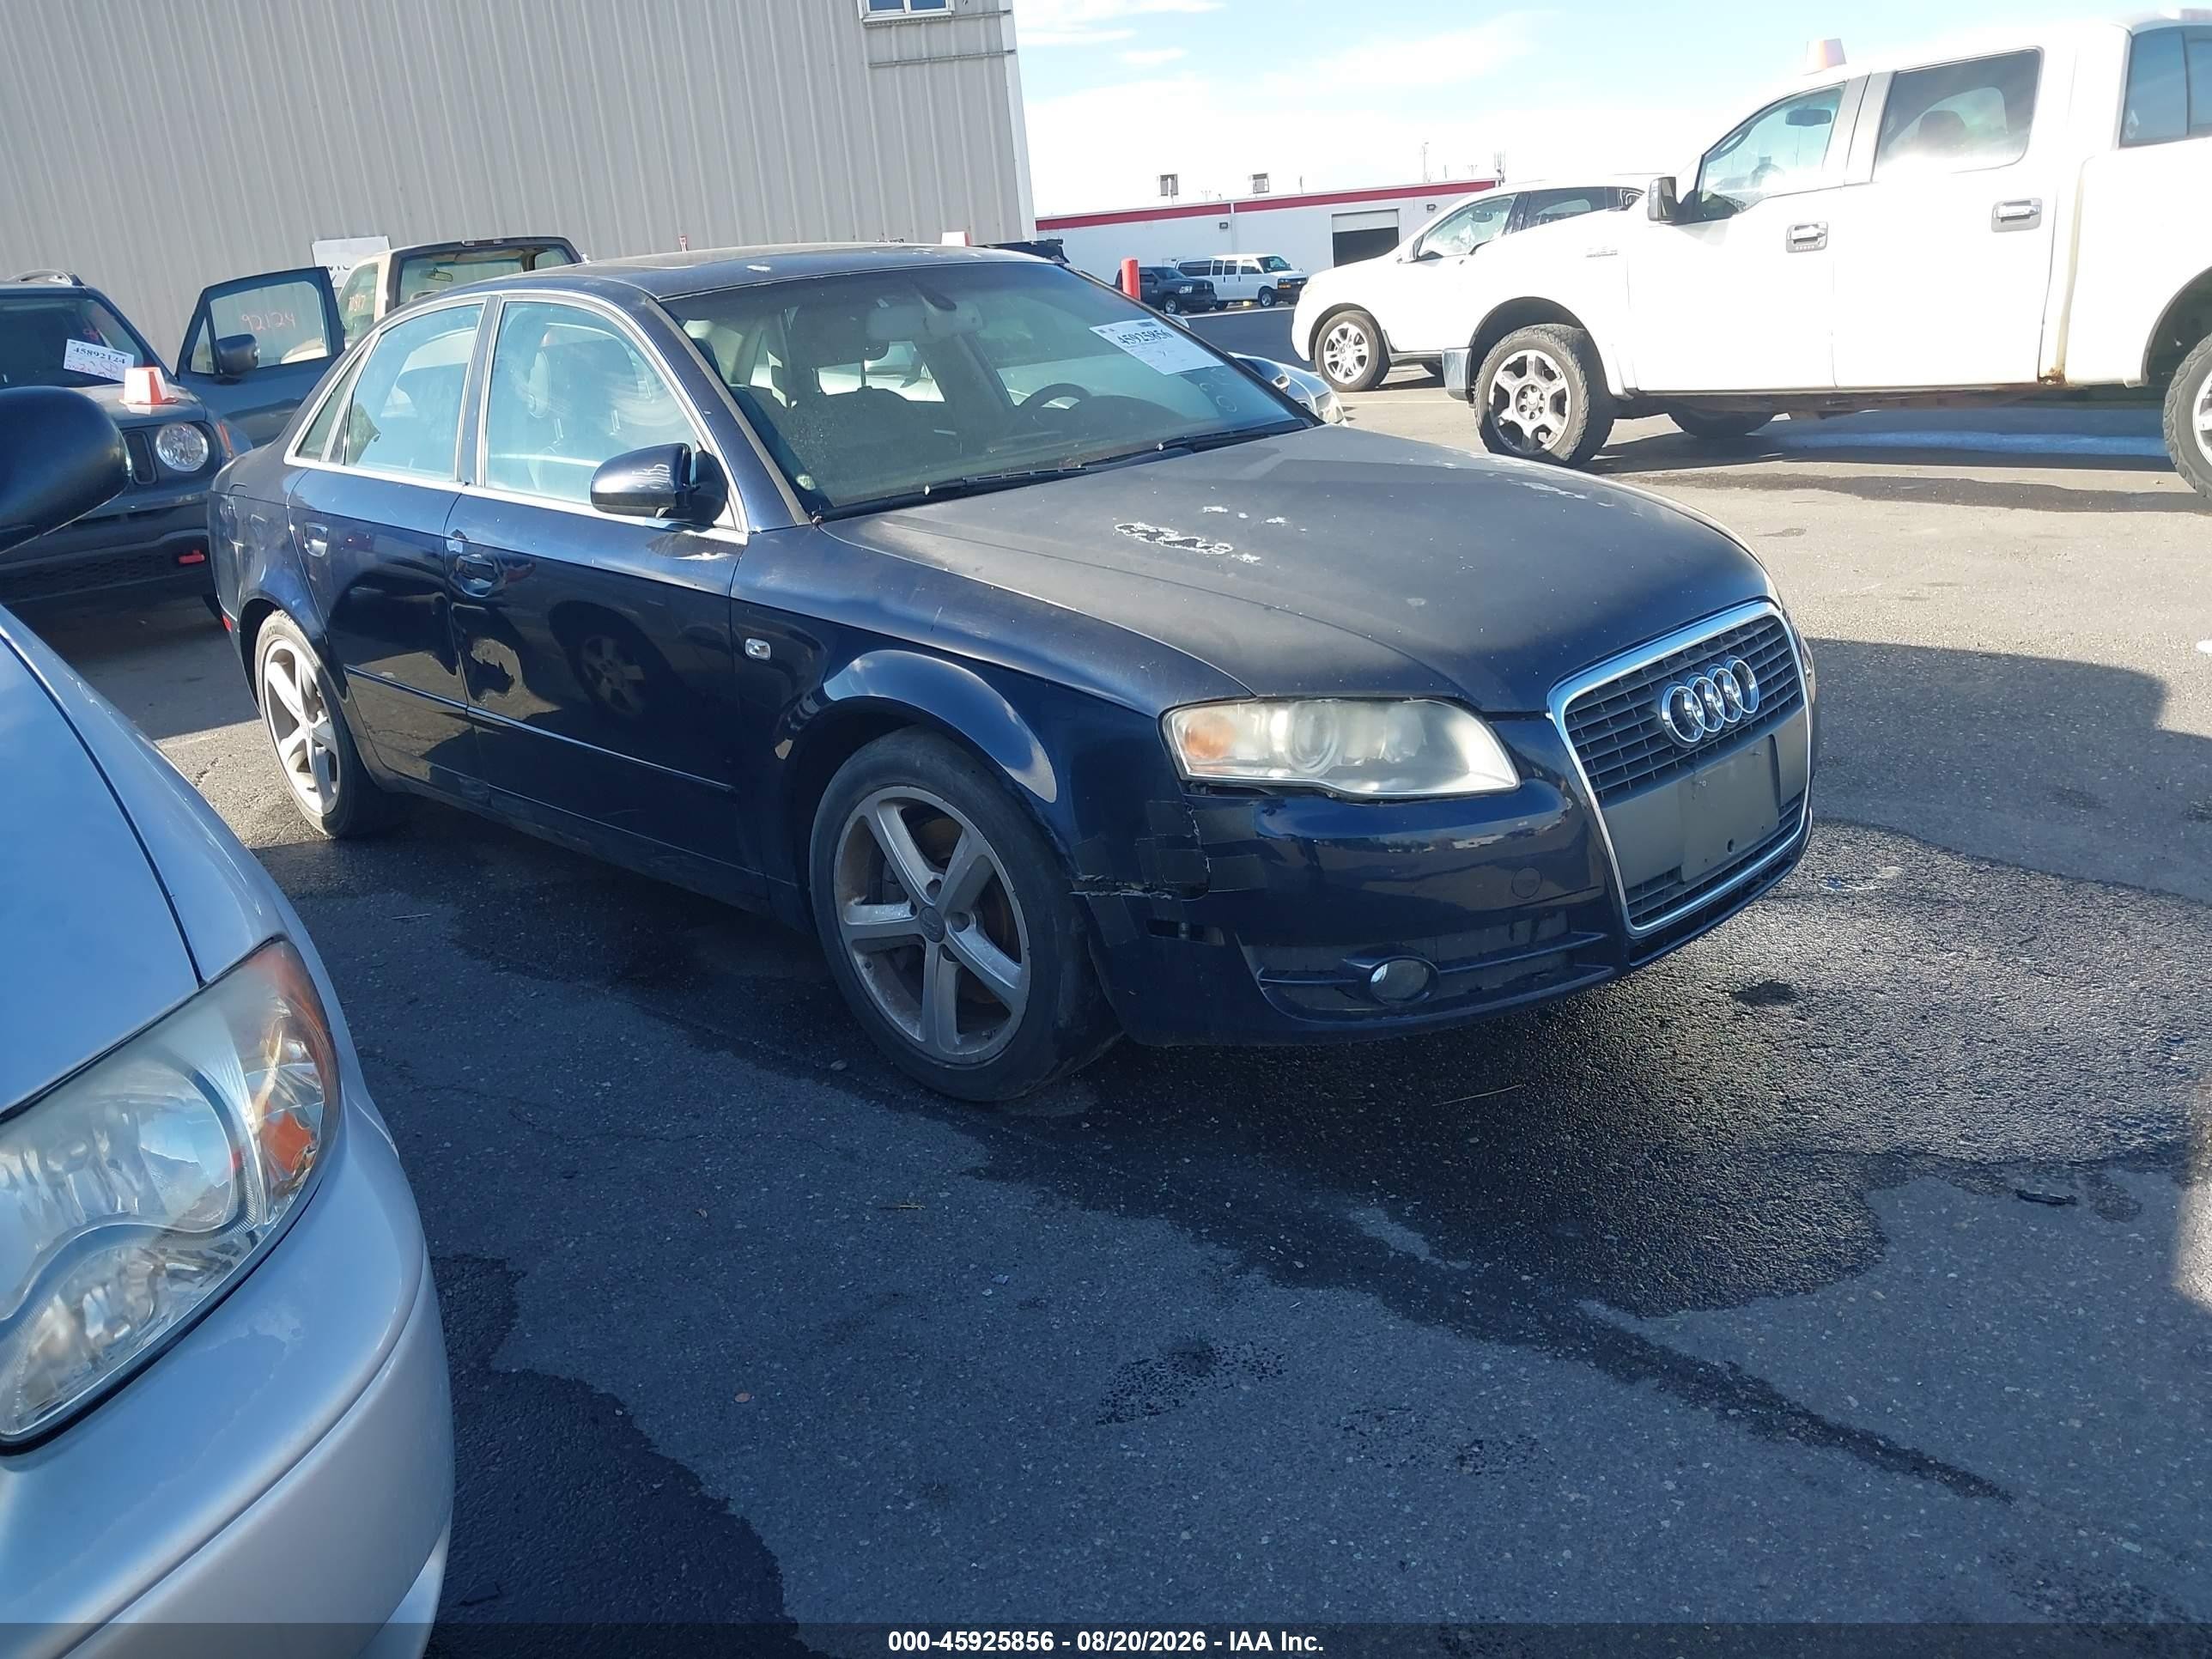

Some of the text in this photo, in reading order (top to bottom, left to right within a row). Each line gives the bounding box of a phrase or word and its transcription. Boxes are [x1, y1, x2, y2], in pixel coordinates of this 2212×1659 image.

[241, 310, 296, 331] 92124
[1116, 329, 1174, 345] 45925856
[73, 347, 125, 364] 45892124
